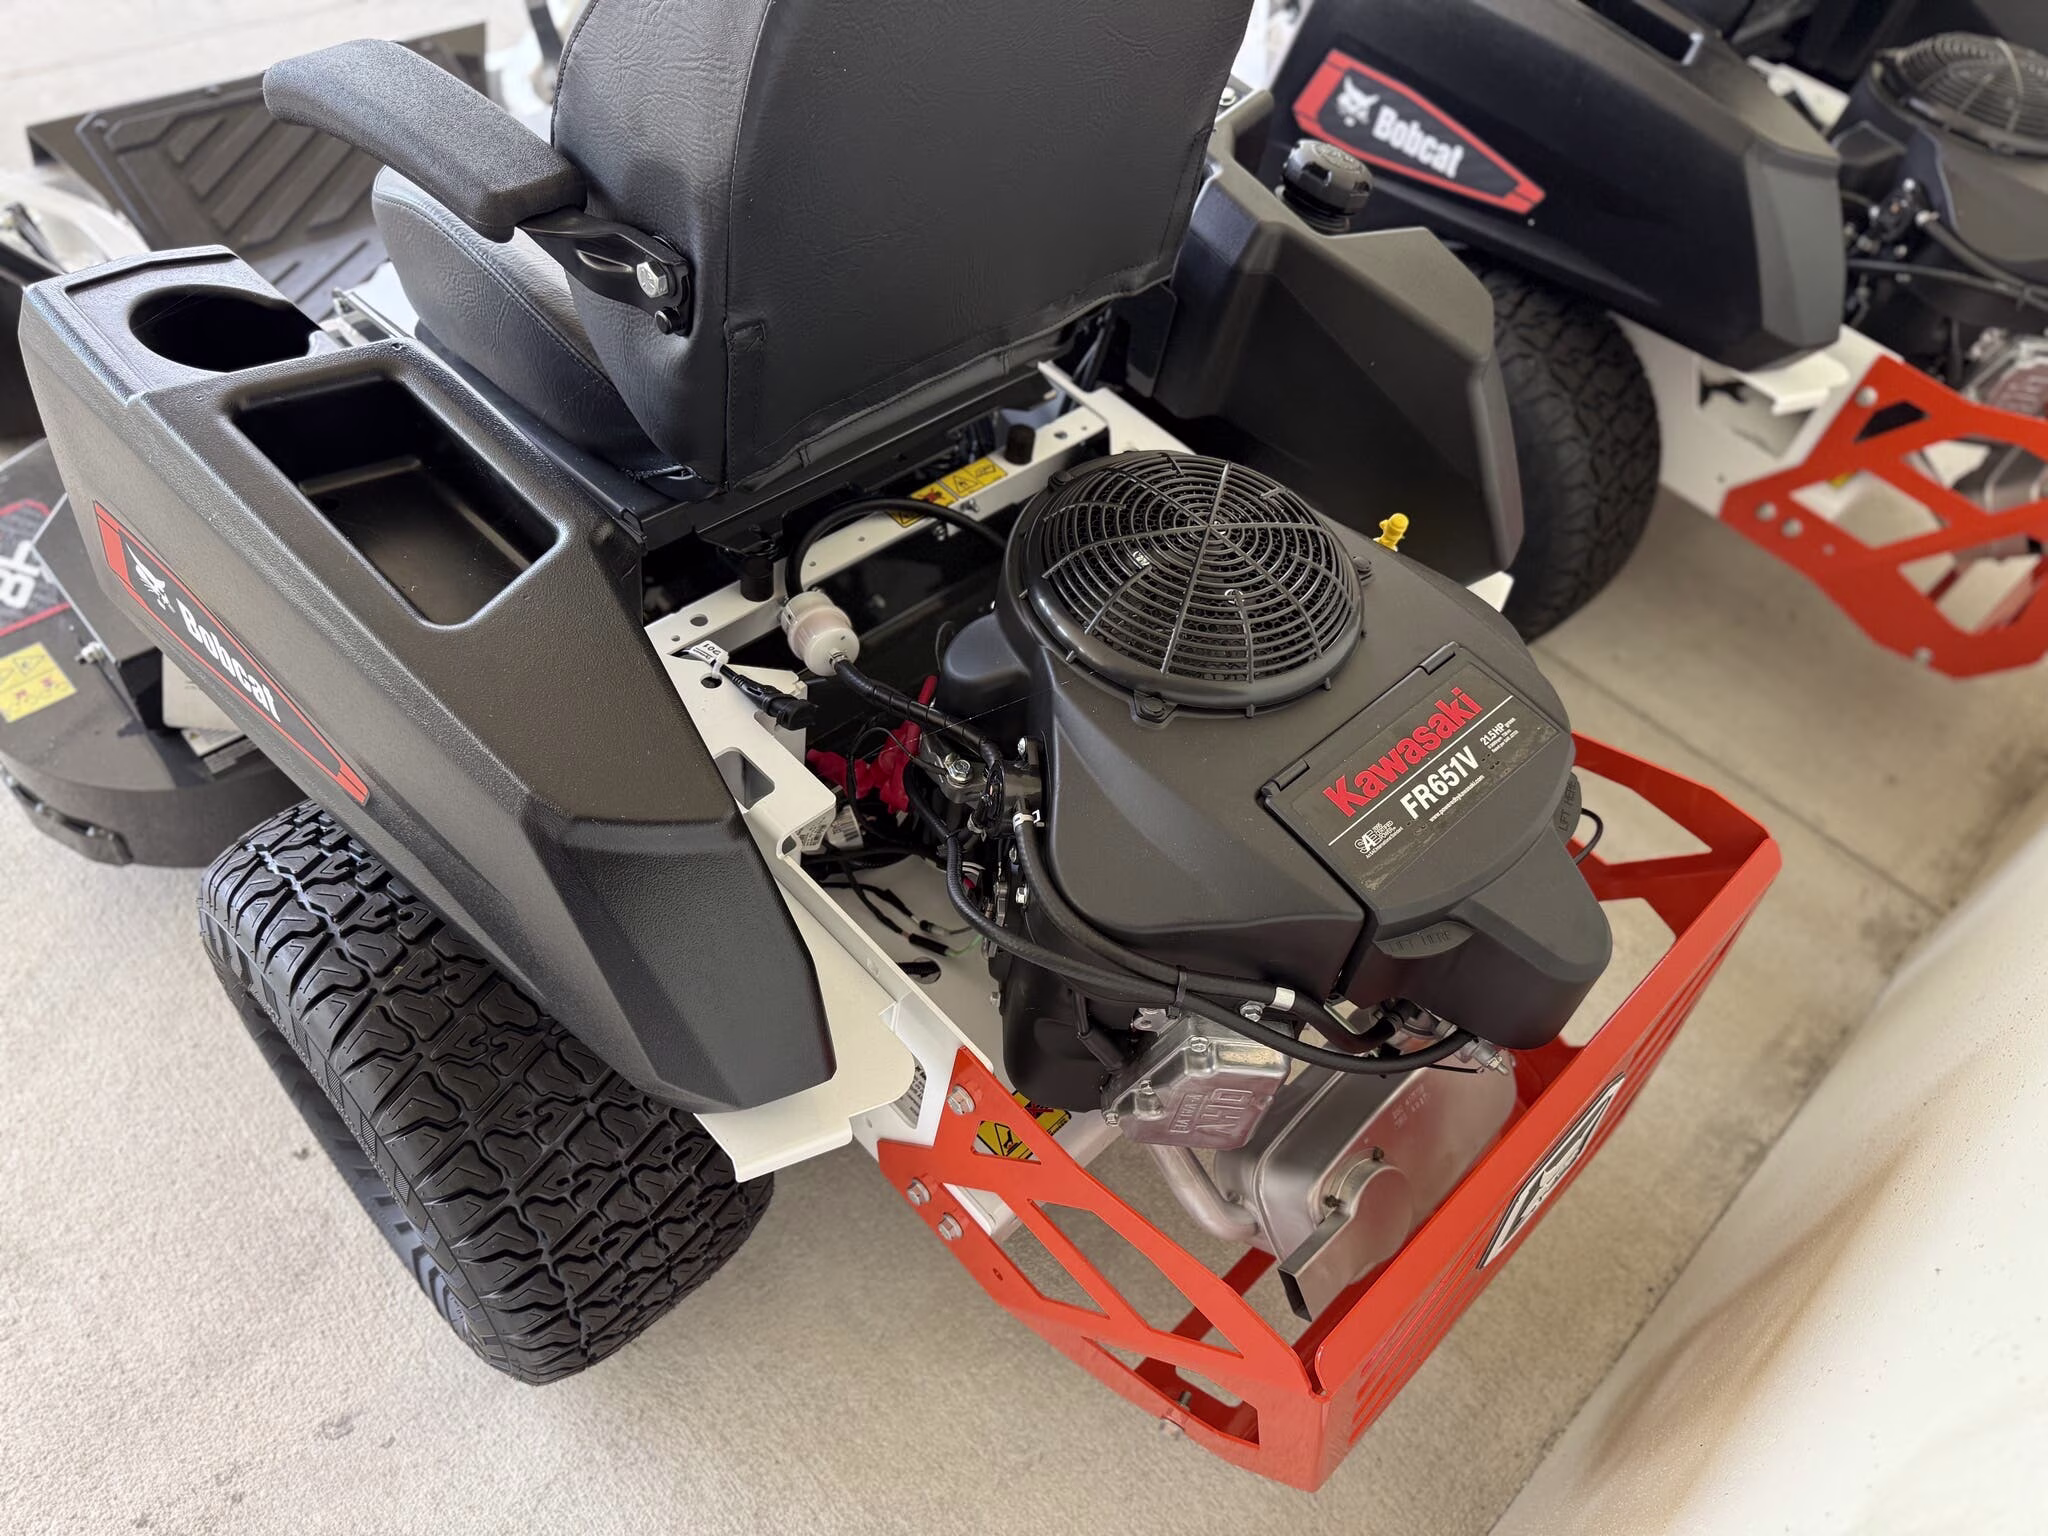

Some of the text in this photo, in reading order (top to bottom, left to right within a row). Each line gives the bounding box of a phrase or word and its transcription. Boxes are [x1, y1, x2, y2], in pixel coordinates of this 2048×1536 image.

[1372, 105, 1464, 179] Bobcat
[176, 598, 281, 723] Bobcat
[1322, 687, 1483, 817] Kawasaki
[1492, 722, 1505, 735] HP
[1400, 746, 1479, 820] FR651V
